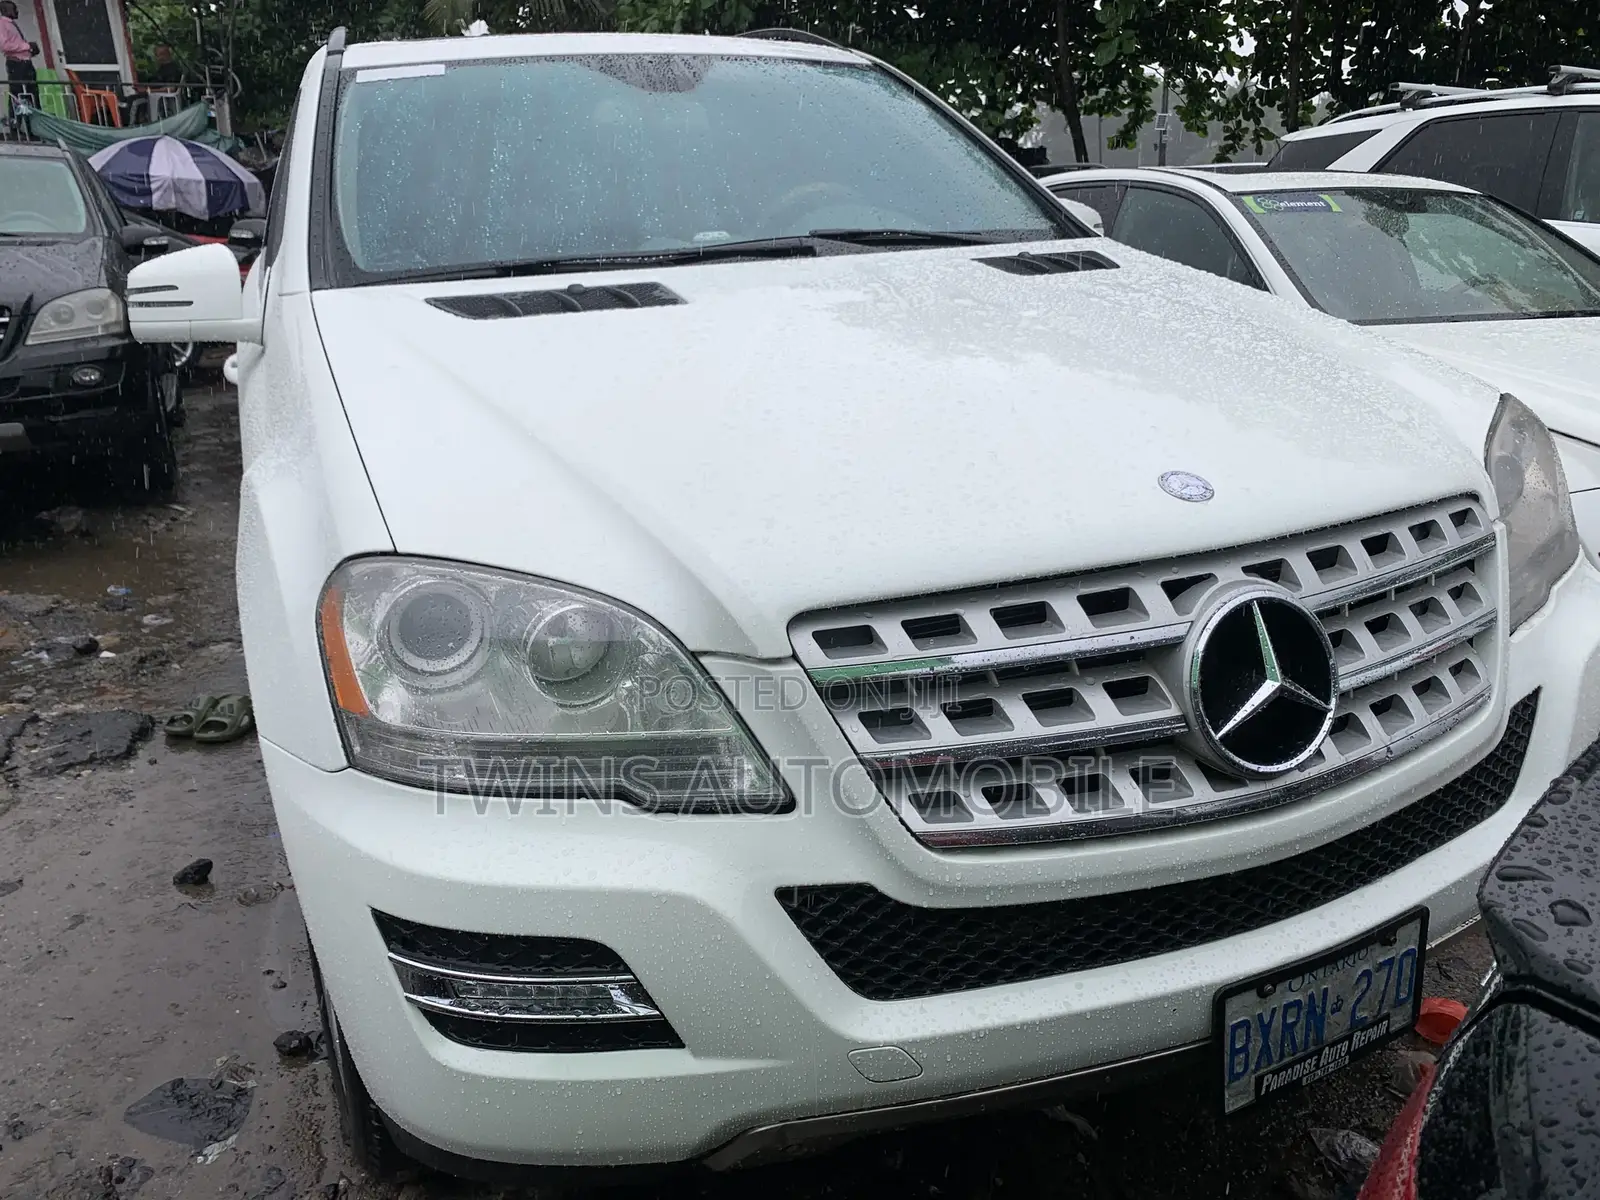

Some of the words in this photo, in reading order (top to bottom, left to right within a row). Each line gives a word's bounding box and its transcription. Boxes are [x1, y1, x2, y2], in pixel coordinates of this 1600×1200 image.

[1279, 200, 1327, 208] element
[1227, 986, 1329, 1084] BXRN
[1350, 947, 1417, 1028] 270
